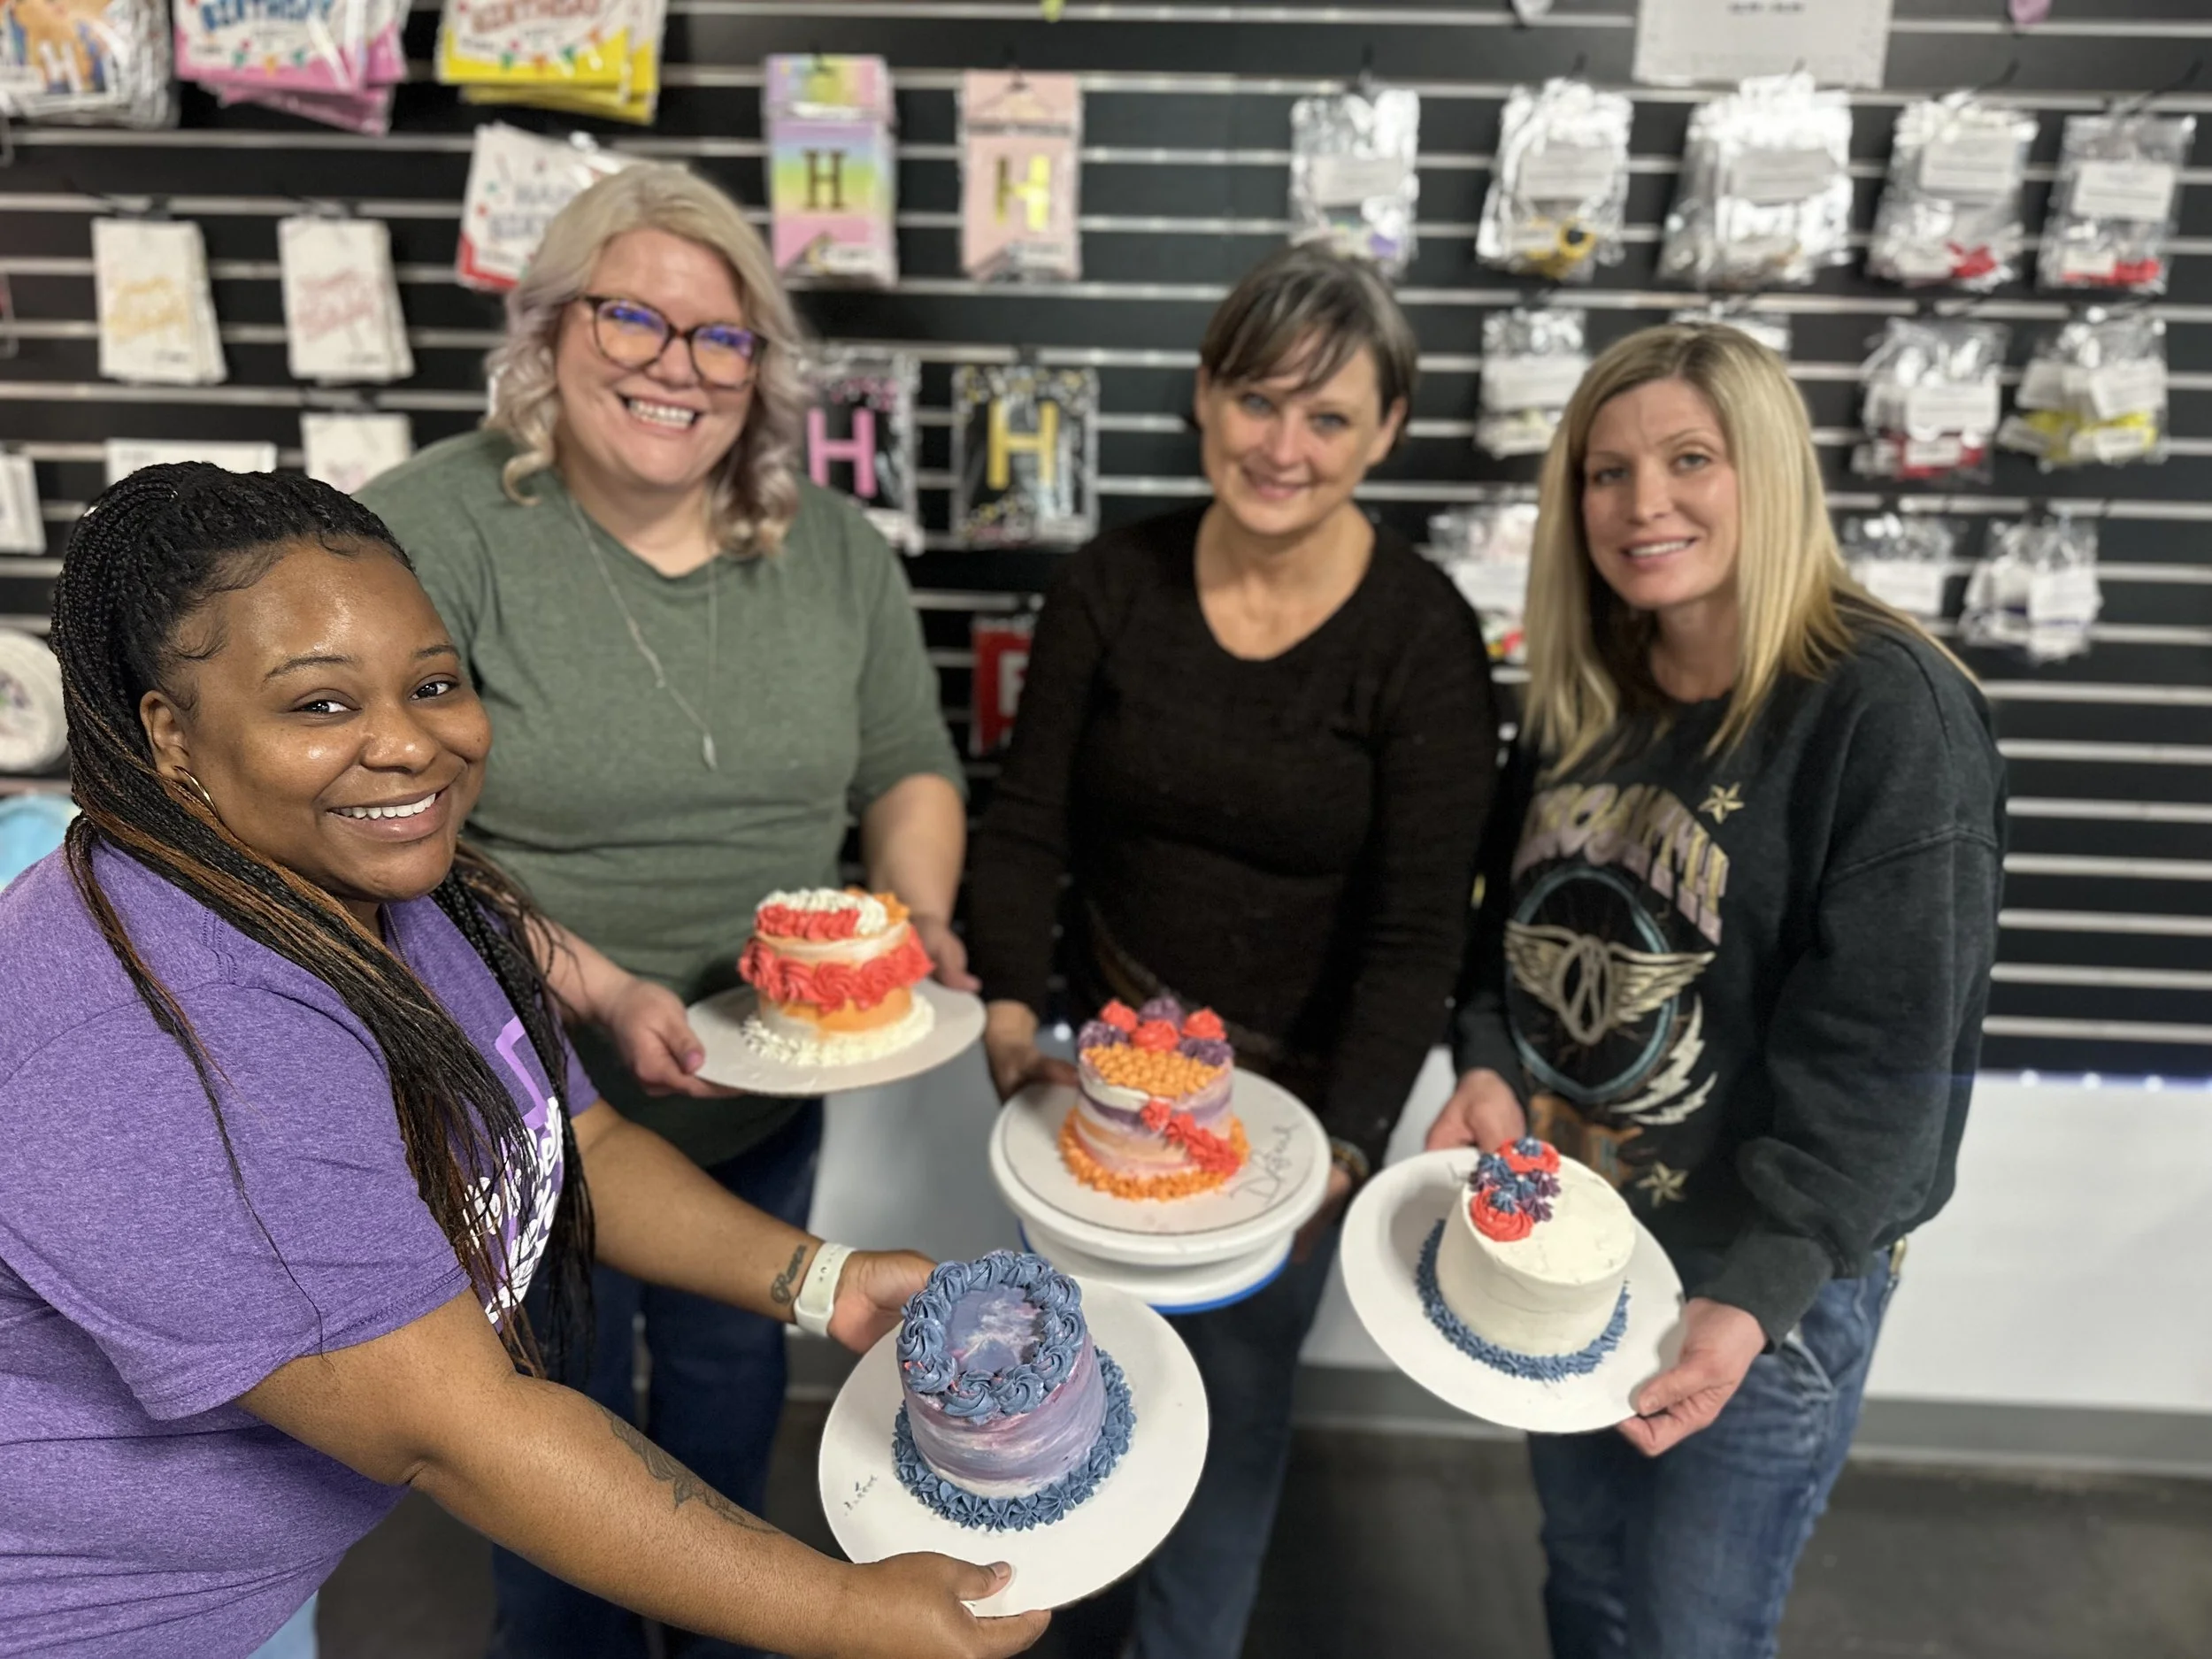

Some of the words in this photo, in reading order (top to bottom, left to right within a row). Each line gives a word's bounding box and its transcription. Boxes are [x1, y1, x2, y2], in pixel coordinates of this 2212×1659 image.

[804, 149, 848, 211] H
[995, 154, 1051, 232] H
[808, 406, 878, 498] H
[986, 398, 1058, 490] H
